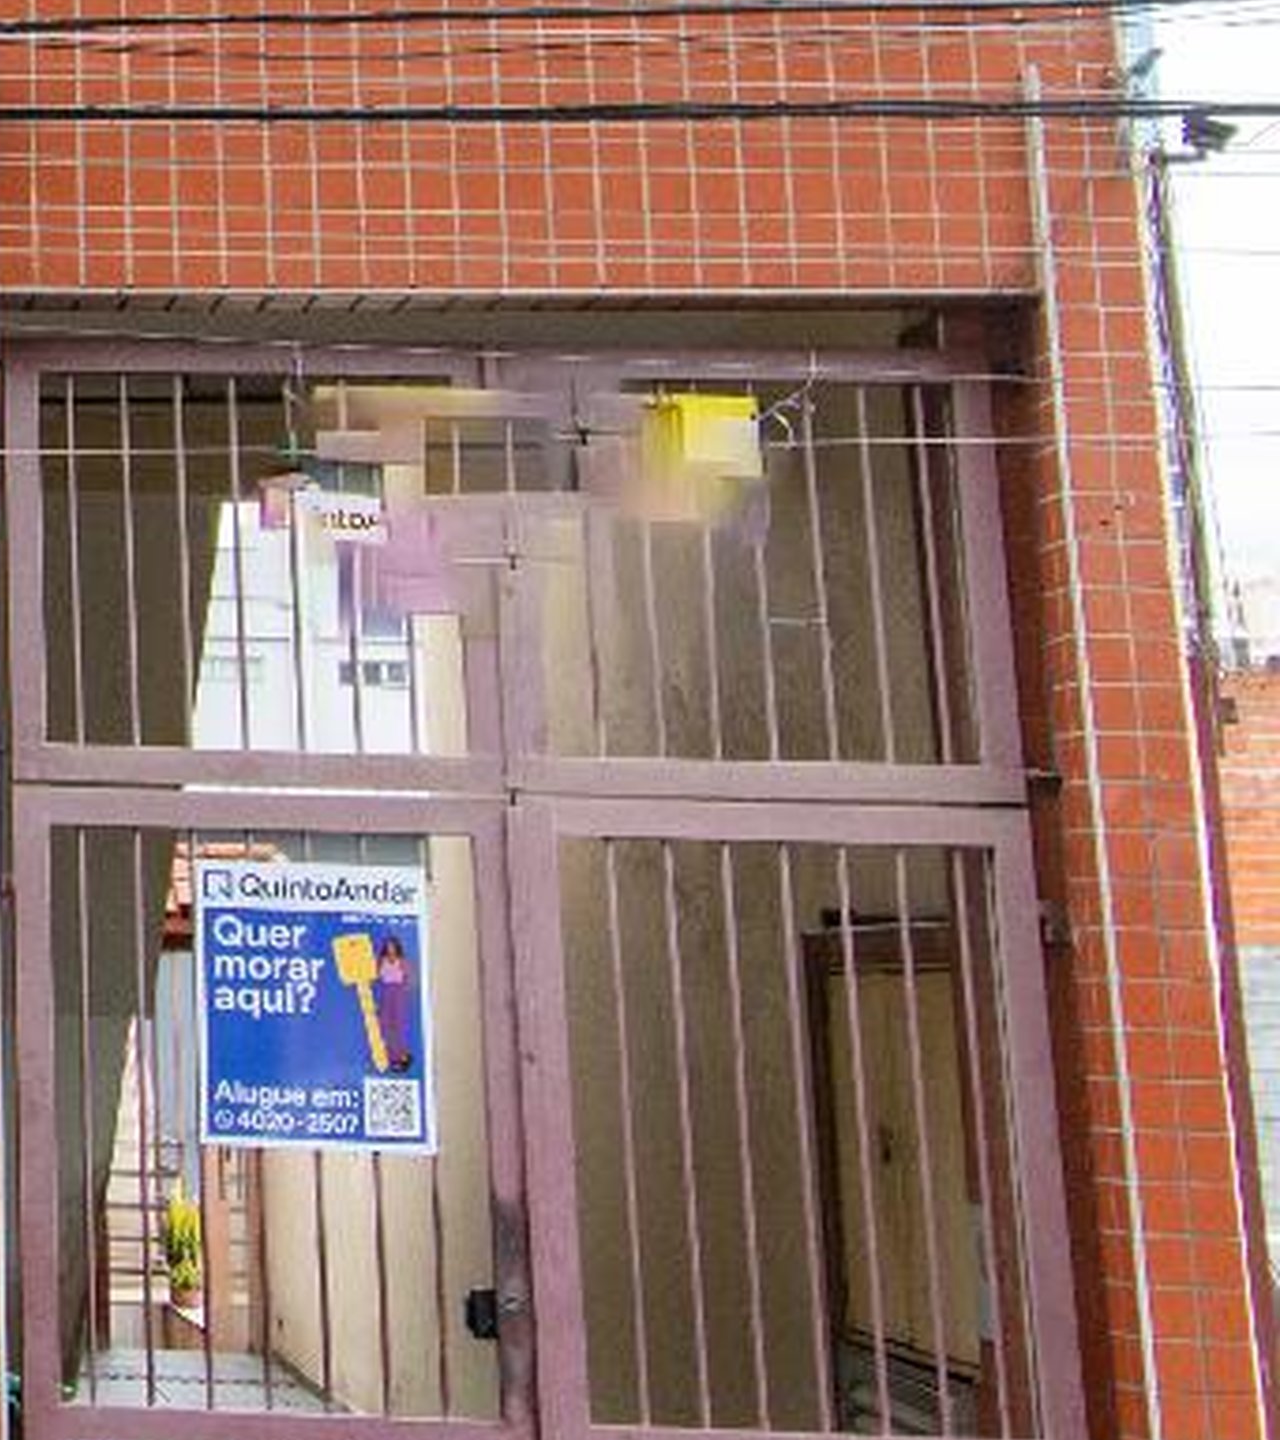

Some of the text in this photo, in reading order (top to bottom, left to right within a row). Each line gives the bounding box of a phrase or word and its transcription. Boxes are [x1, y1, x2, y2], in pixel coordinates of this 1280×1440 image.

[240, 873, 417, 904] QuintoAndar
[213, 915, 307, 949] Quer
[213, 955, 325, 982] morar
[213, 982, 316, 1020] aqui?
[214, 1079, 359, 1111] Alugue em:
